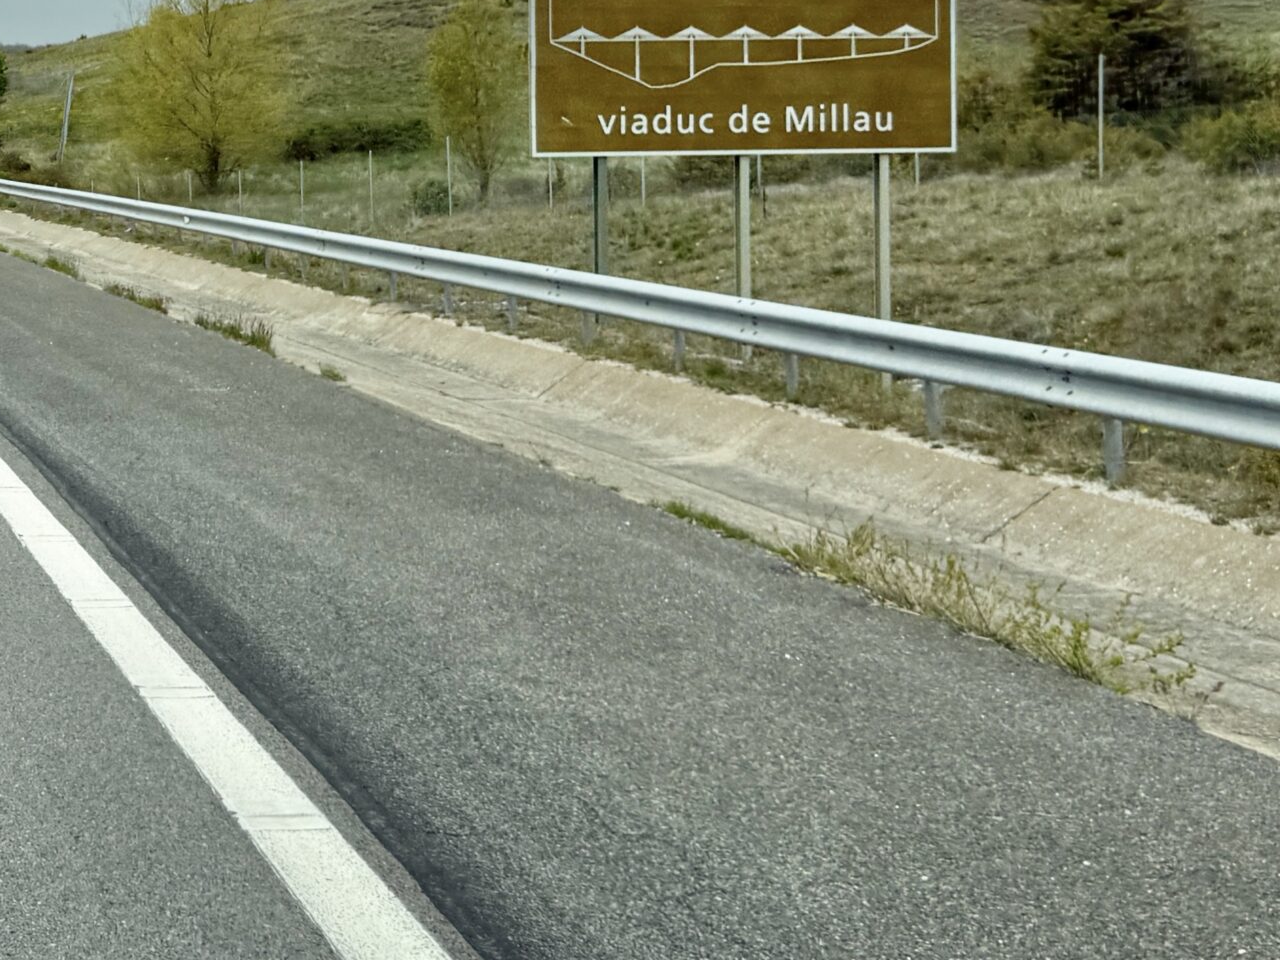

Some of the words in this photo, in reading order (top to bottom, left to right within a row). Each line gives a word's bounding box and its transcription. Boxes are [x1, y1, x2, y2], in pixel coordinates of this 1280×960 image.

[597, 106, 714, 135] viaduc
[728, 104, 771, 134] de
[785, 103, 894, 133] Millau
